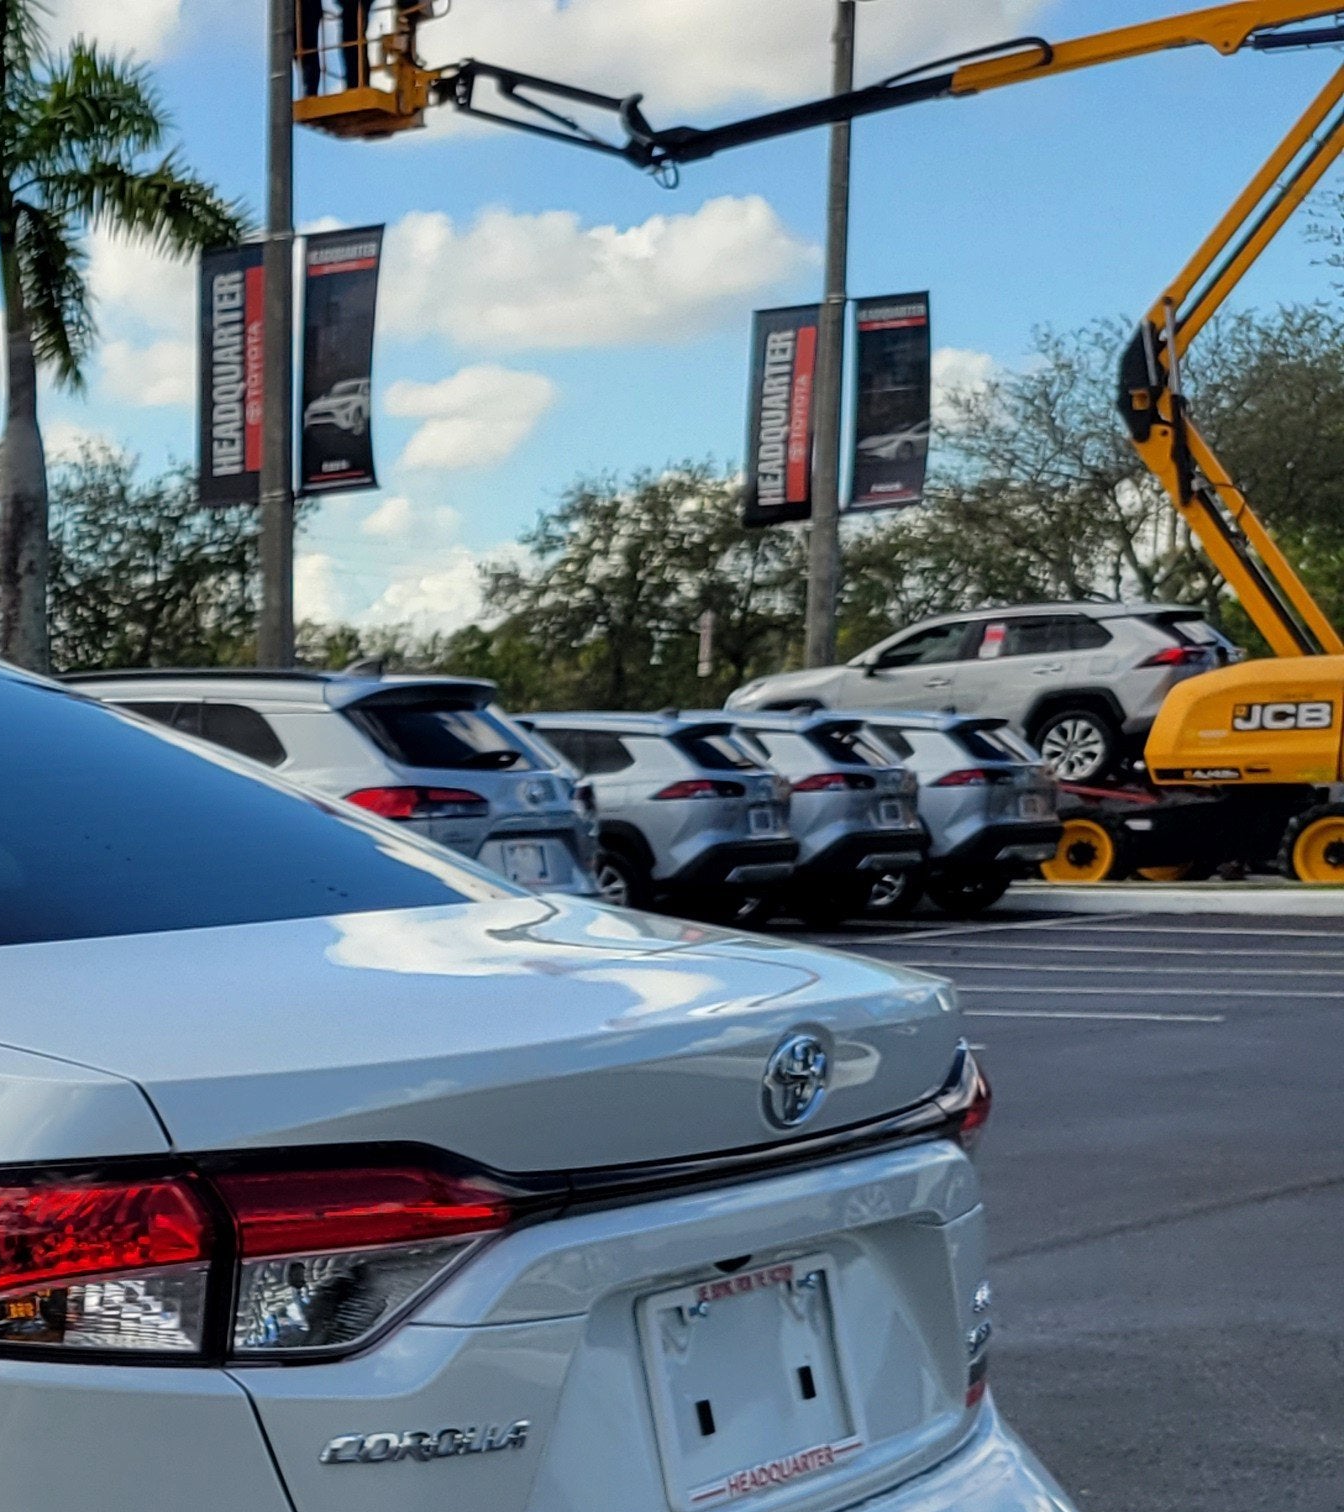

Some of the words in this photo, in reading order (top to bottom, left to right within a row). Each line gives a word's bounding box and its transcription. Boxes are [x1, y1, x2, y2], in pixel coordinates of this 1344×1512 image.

[212, 270, 246, 477] HEADQUARTER
[246, 320, 264, 403] TOYOTA
[757, 329, 796, 506] HEADQUARTER
[1233, 701, 1333, 731] JCB
[319, 1419, 531, 1464] COROLLA
[728, 1445, 835, 1495] HEADQUARTER
